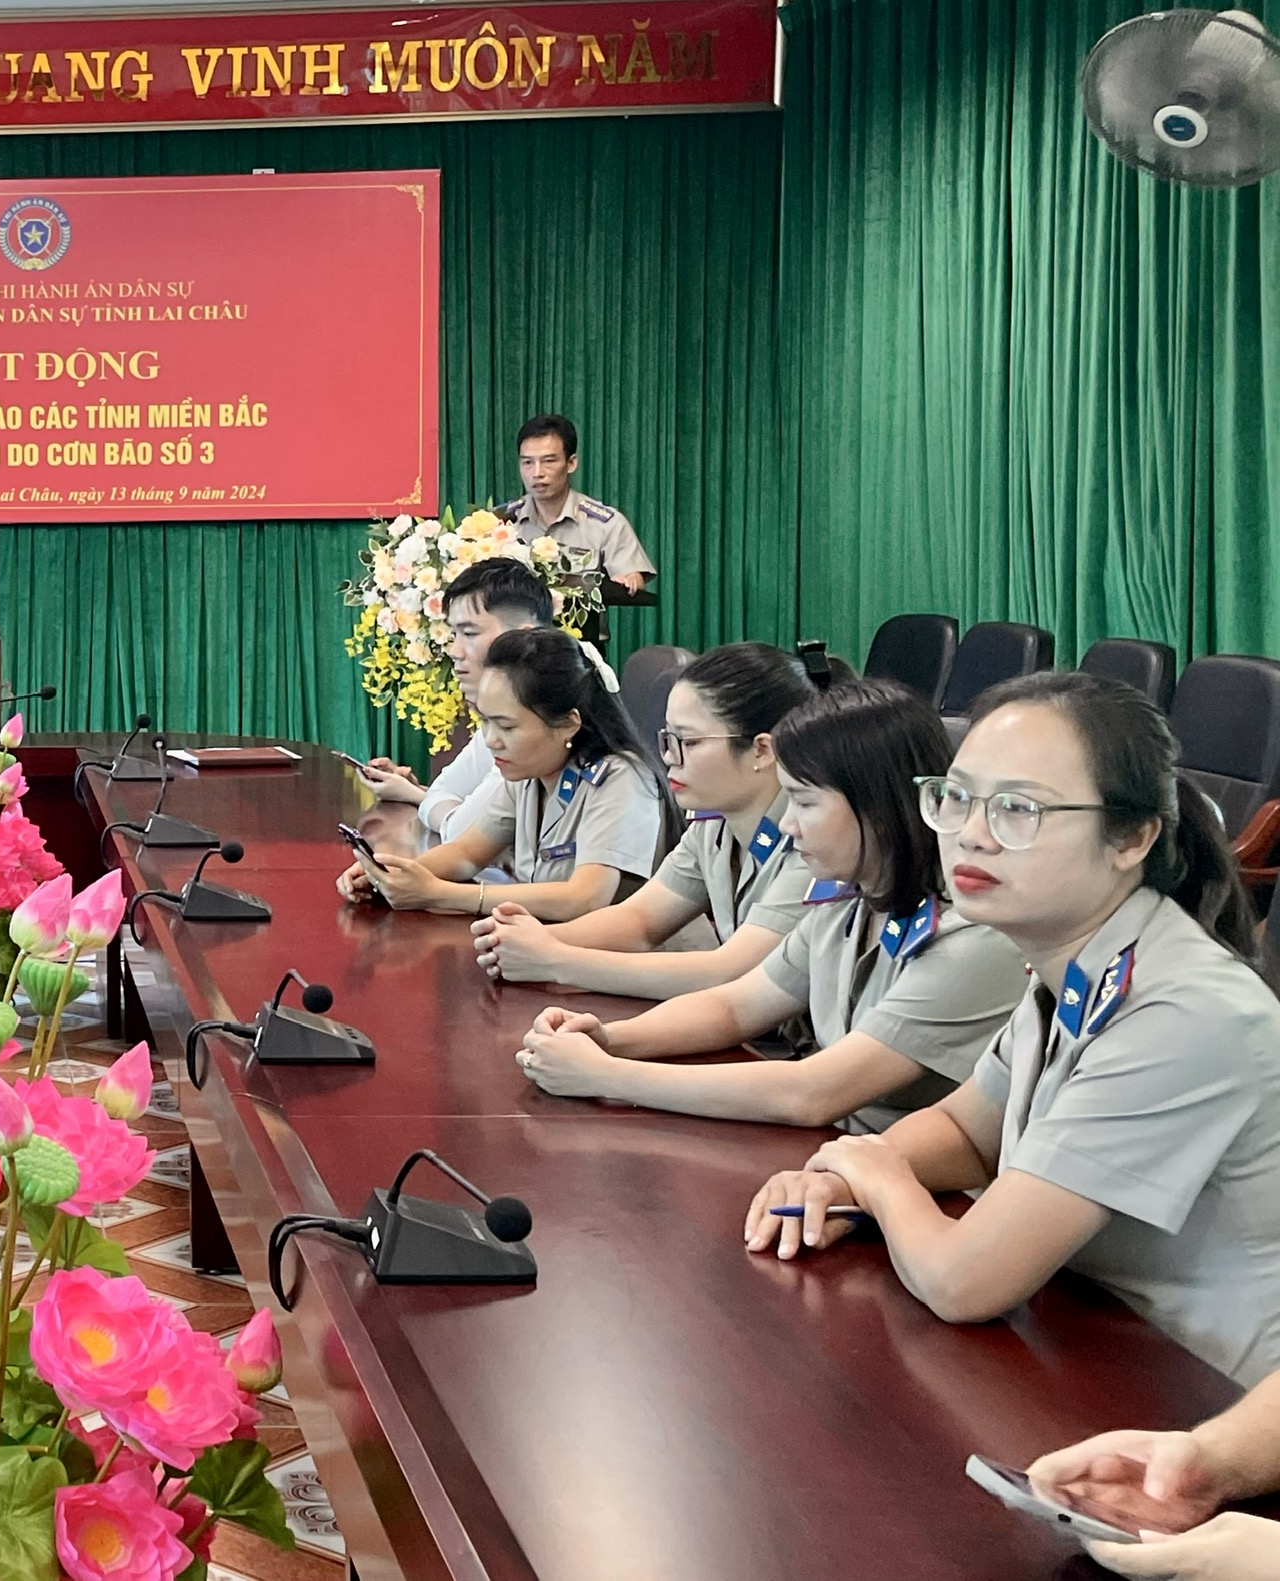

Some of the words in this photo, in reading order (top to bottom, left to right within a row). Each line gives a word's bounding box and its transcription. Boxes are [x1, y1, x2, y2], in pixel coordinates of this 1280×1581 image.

[181, 44, 346, 98] VINH
[368, 21, 557, 94] MUÔN
[574, 17, 718, 86] NĂM
[21, 280, 78, 299] HÀNH
[84, 278, 113, 299] ÁN
[118, 278, 162, 298] DÂN
[166, 279, 196, 300] SỰ
[11, 303, 54, 324] DÂN
[59, 304, 88, 327] SỰ
[90, 302, 141, 322] TỈNH
[148, 305, 184, 322] LAI
[188, 300, 249, 321] CHÂU
[34, 347, 161, 388] ĐỘNG
[29, 400, 79, 430] CÁC
[84, 397, 141, 429] TỈNH
[147, 396, 212, 429] MIỀN
[218, 394, 269, 428] BẮC
[7, 443, 40, 468] DO
[46, 440, 98, 467] CƠN
[104, 438, 153, 466] BÃO
[160, 433, 193, 465] SỐ
[199, 441, 216, 465] 3
[18, 486, 65, 505] Châu,
[67, 486, 106, 505] ngày
[109, 486, 127, 502] 13
[130, 486, 175, 505] tháng
[178, 485, 189, 501] 9
[191, 486, 226, 501] năm
[229, 484, 268, 501] 2024
